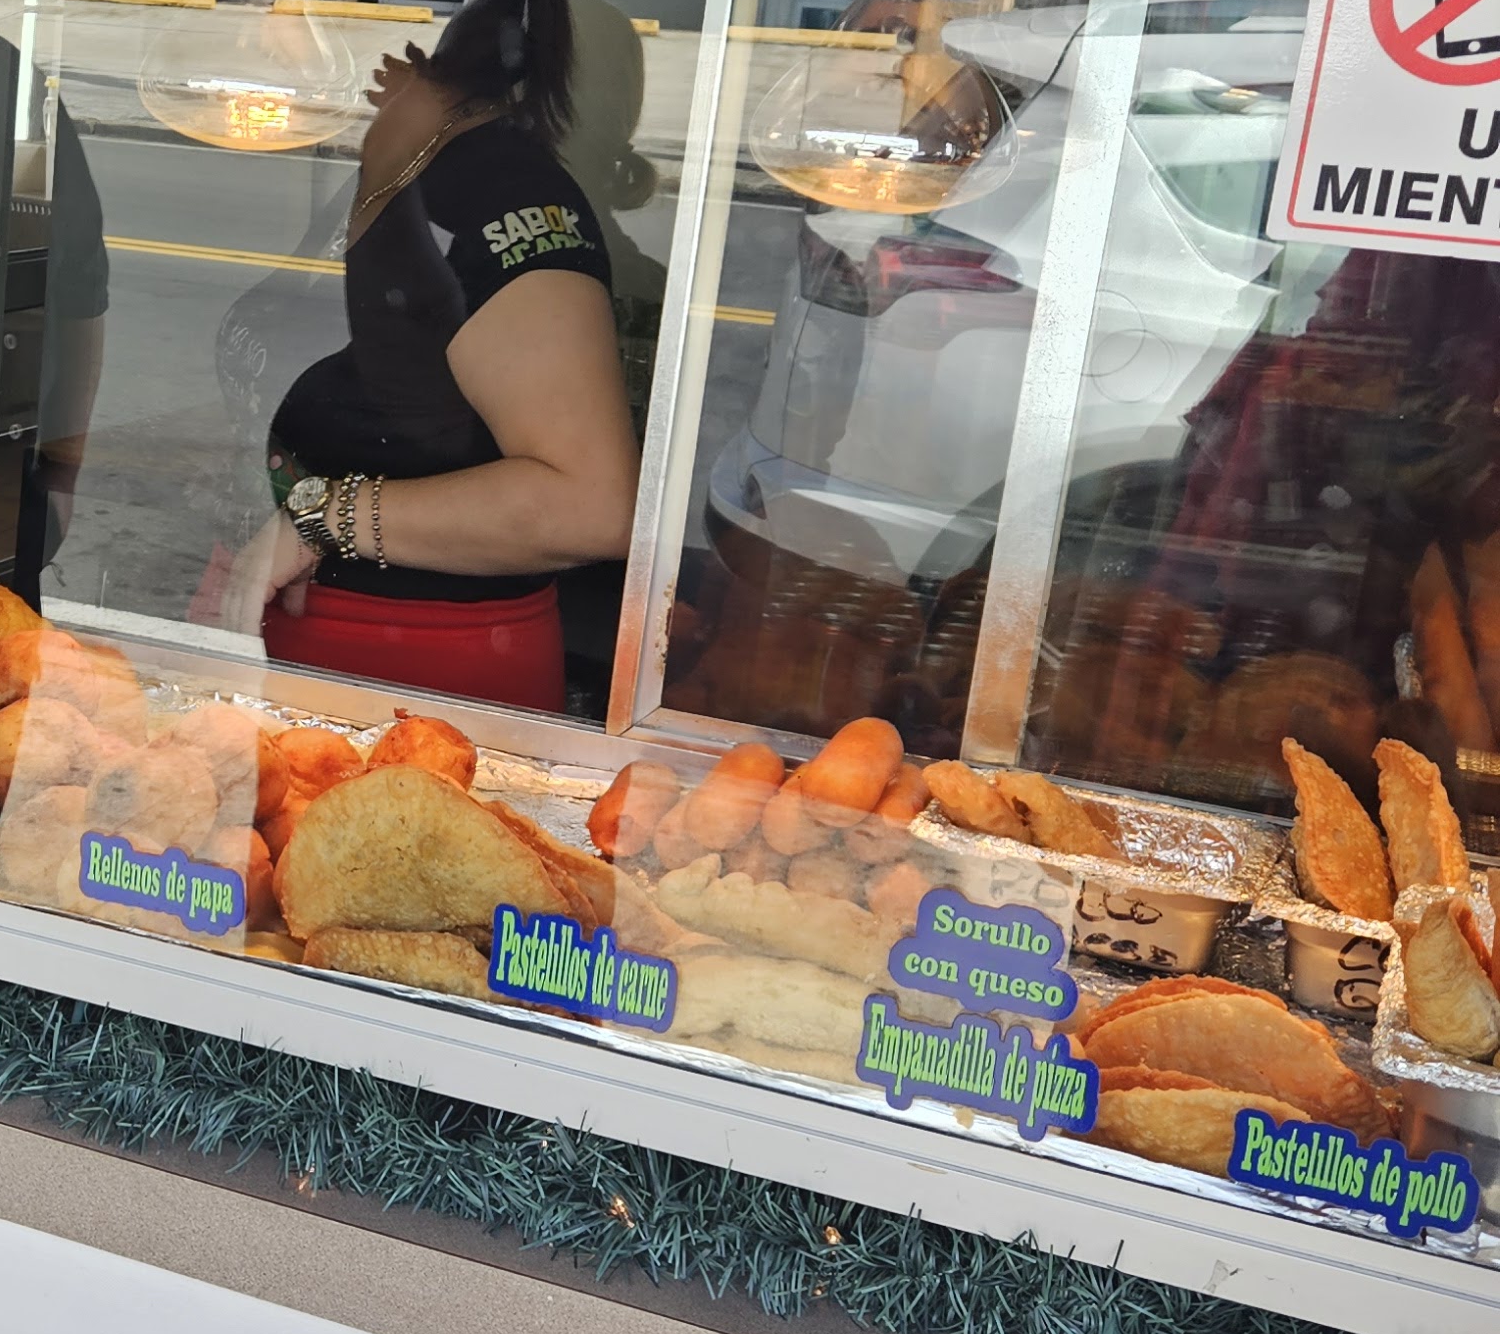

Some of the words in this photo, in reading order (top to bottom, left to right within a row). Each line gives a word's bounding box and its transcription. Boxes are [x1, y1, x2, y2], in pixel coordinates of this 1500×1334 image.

[1312, 163, 1500, 228] MIEN
[88, 841, 162, 897] Rellenos
[166, 860, 186, 902] de
[189, 877, 234, 923] papa
[933, 905, 1052, 956] Sorullo
[591, 934, 615, 1008] de
[617, 958, 669, 1021] carne
[903, 950, 958, 983] con
[967, 967, 1065, 1008] queso
[864, 1002, 997, 1098] Empanadilla
[1000, 1035, 1028, 1104] de
[1025, 1043, 1088, 1128] pizza
[1369, 1148, 1401, 1206] de
[1398, 1162, 1467, 1227] pollo
